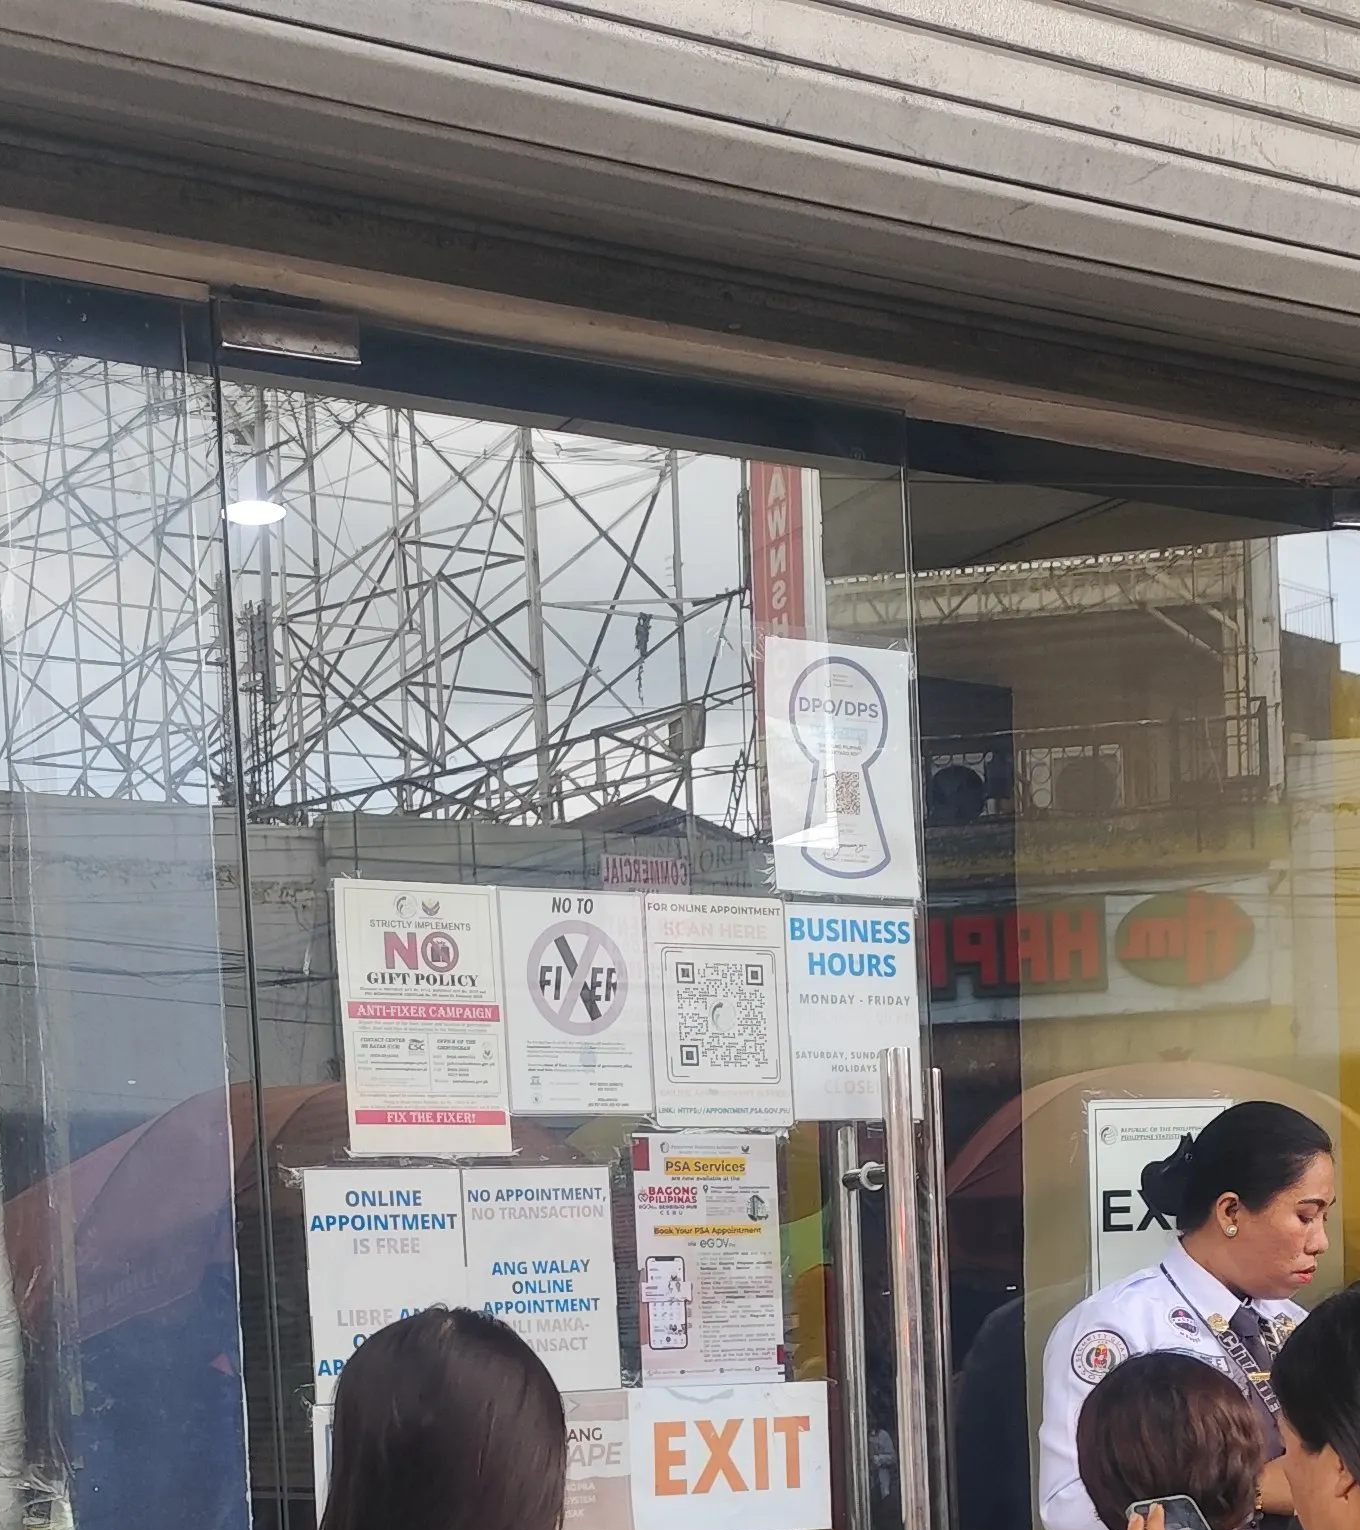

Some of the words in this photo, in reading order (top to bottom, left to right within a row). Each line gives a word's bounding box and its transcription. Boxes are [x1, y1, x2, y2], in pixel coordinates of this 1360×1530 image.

[798, 697, 880, 719] DPO/DPS
[552, 897, 571, 914] NO
[577, 898, 594, 914] TO
[647, 902, 667, 911] FOR
[671, 904, 708, 913] ONLINE
[710, 905, 781, 916] APPOINTMENT
[370, 919, 412, 929] STRICTLY
[415, 921, 471, 931] IMPLEMENTS
[790, 917, 911, 945] BUSINESS
[808, 952, 897, 978] HOURS
[366, 971, 411, 986] GIFT
[414, 973, 479, 987] POLICY
[799, 993, 855, 1005] MONDAY
[868, 995, 911, 1007] FRIDAY
[357, 1004, 427, 1018] ANTI-FIXER
[429, 1006, 492, 1019] CAMPAIGN
[851, 1052, 881, 1060] SUNDA
[831, 1064, 878, 1073] HOLIDAYS
[824, 1079, 881, 1095] CLOSE
[387, 1112, 407, 1123] FIX
[409, 1112, 434, 1123] THE
[437, 1112, 476, 1124] FIXER!
[665, 1160, 691, 1172] PSA
[694, 1159, 746, 1172] Services
[345, 1190, 422, 1207] ONLINE
[467, 1189, 491, 1203] NO
[495, 1188, 606, 1203] APPOINTMENT,
[648, 1186, 698, 1195] BAGONG
[648, 1195, 698, 1204] PILIPINAS
[471, 1207, 495, 1221] NO
[499, 1205, 604, 1220] TRANSACTION
[1103, 1190, 1174, 1232] EX
[310, 1214, 458, 1232] APPOINTMENT
[353, 1238, 370, 1255] IS
[376, 1237, 420, 1255] FREE
[492, 1261, 527, 1276] ANG
[532, 1259, 591, 1274] WALAY
[512, 1279, 573, 1295] ONLINE
[483, 1298, 600, 1316] APPOINTMENT
[527, 1337, 588, 1352] ANSACT
[567, 1427, 603, 1443] ANG
[566, 1441, 624, 1467] APE
[653, 1415, 810, 1497] EXIT
